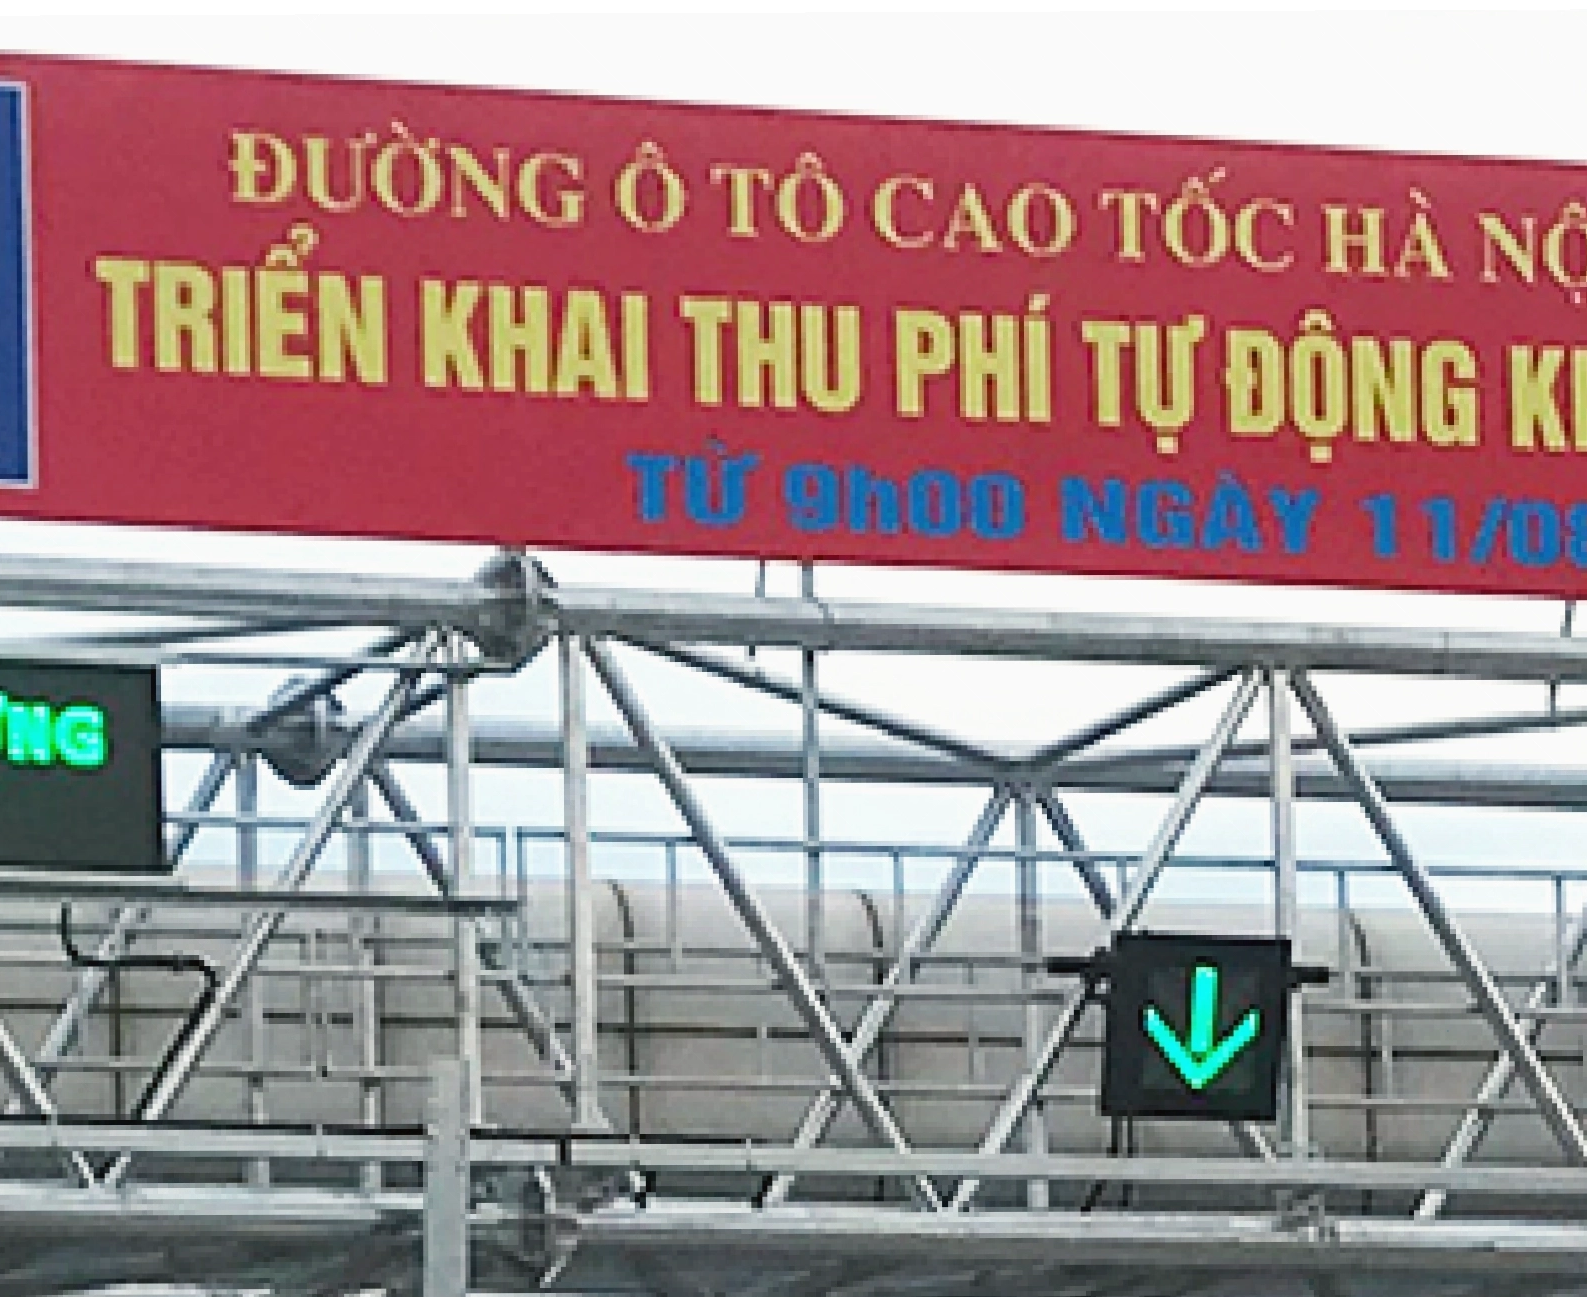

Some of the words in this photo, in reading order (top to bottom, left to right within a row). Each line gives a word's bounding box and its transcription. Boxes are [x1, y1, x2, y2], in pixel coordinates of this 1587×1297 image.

[229, 121, 585, 227] ĐƯỜNG
[614, 138, 688, 234] Ô
[709, 152, 843, 243] TÔ
[871, 178, 1077, 260] CAO
[1101, 168, 1298, 272] TỐC
[1322, 188, 1449, 279] HÀ
[94, 225, 386, 387] TRIỂN
[422, 285, 649, 402] KHAI
[680, 295, 862, 414] THU
[895, 293, 1053, 424] PHÍ
[1080, 314, 1206, 455] TỰ
[1225, 310, 1476, 463] ĐỘNG
[629, 437, 756, 524] TỪ
[784, 460, 1024, 539] 9h00
[1061, 466, 1320, 557] NGÀY
